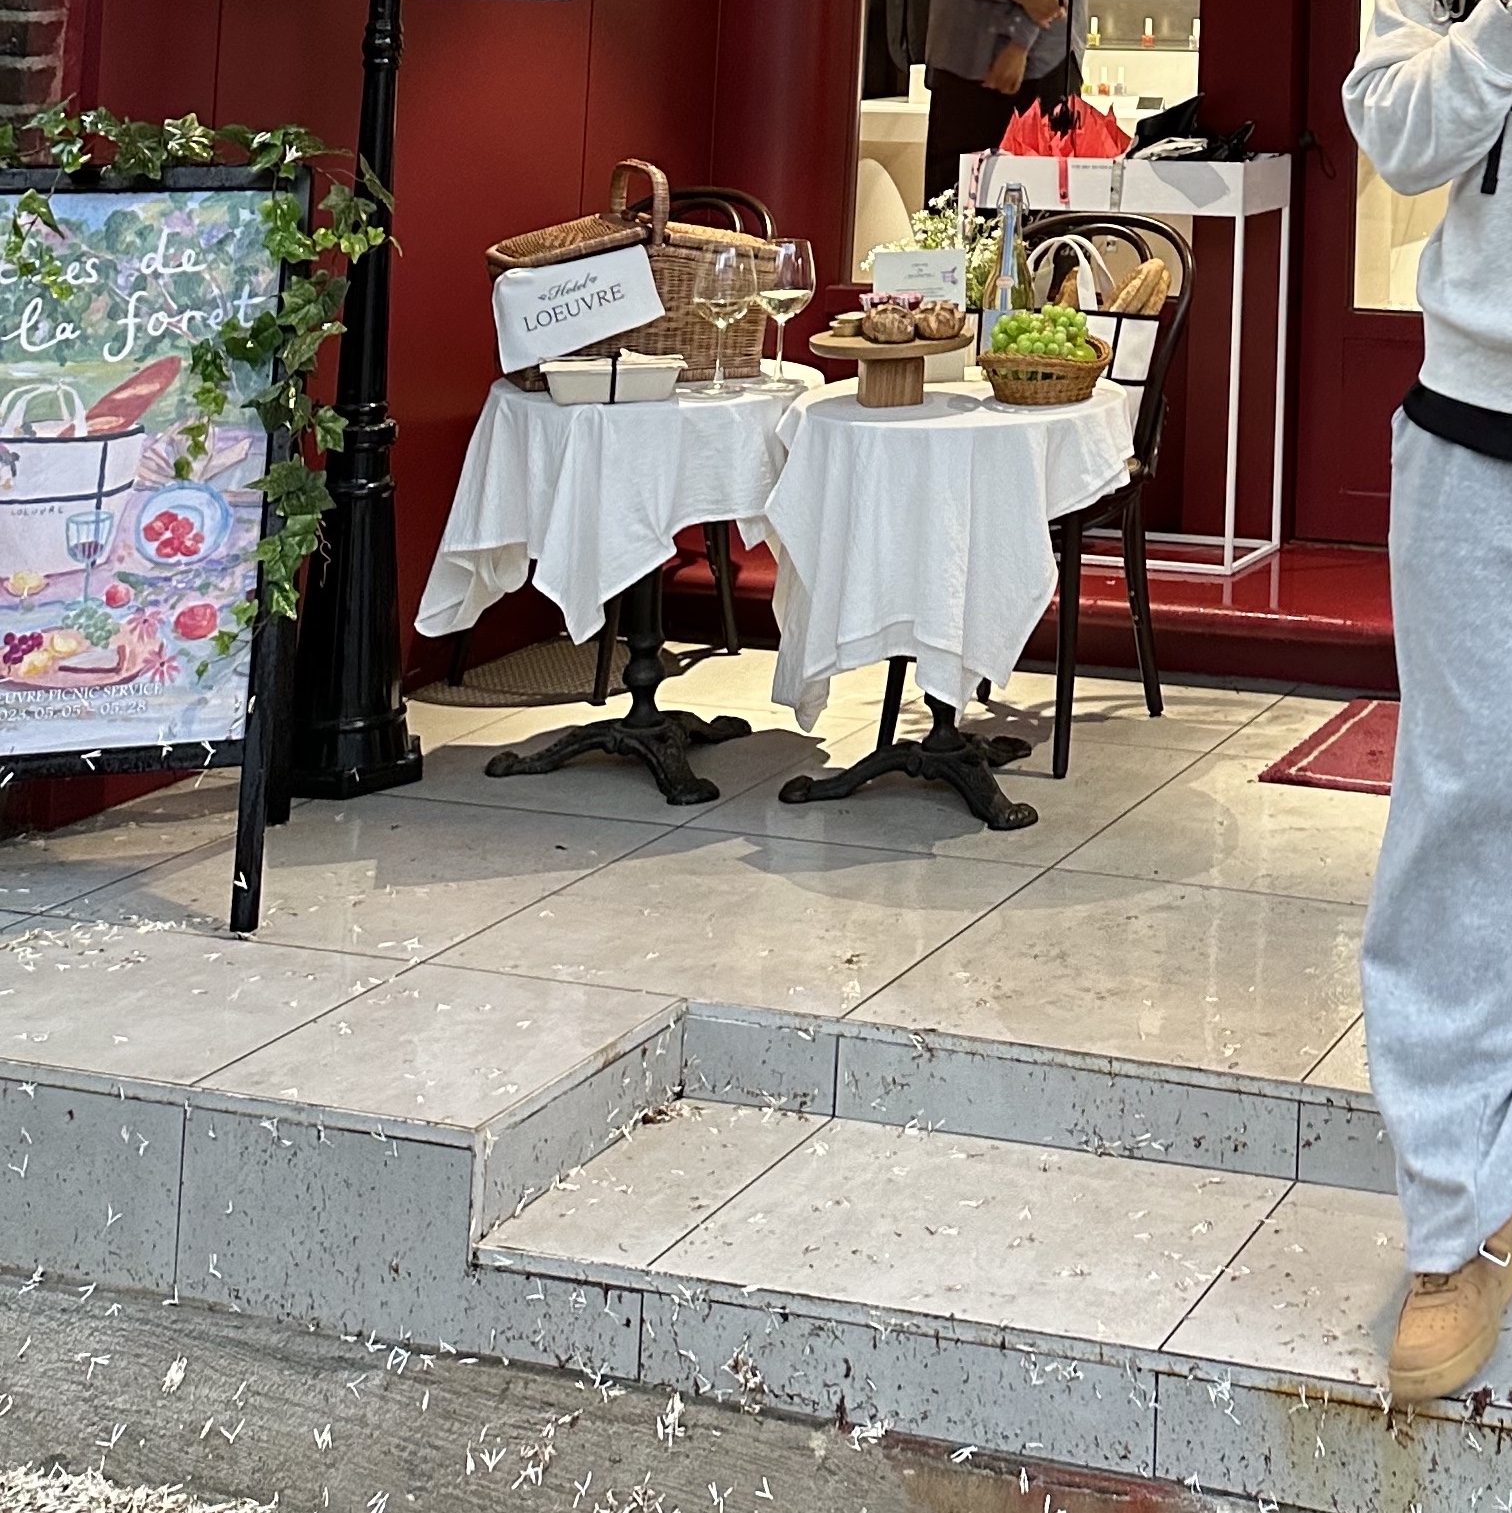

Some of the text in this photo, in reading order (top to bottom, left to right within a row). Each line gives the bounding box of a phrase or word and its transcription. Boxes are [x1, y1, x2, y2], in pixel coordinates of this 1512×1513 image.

[140, 227, 207, 275] de
[4, 297, 82, 352] la
[523, 283, 626, 332] LOEUVRE
[50, 686, 99, 702] PICNIC
[103, 683, 164, 698] SERVICE
